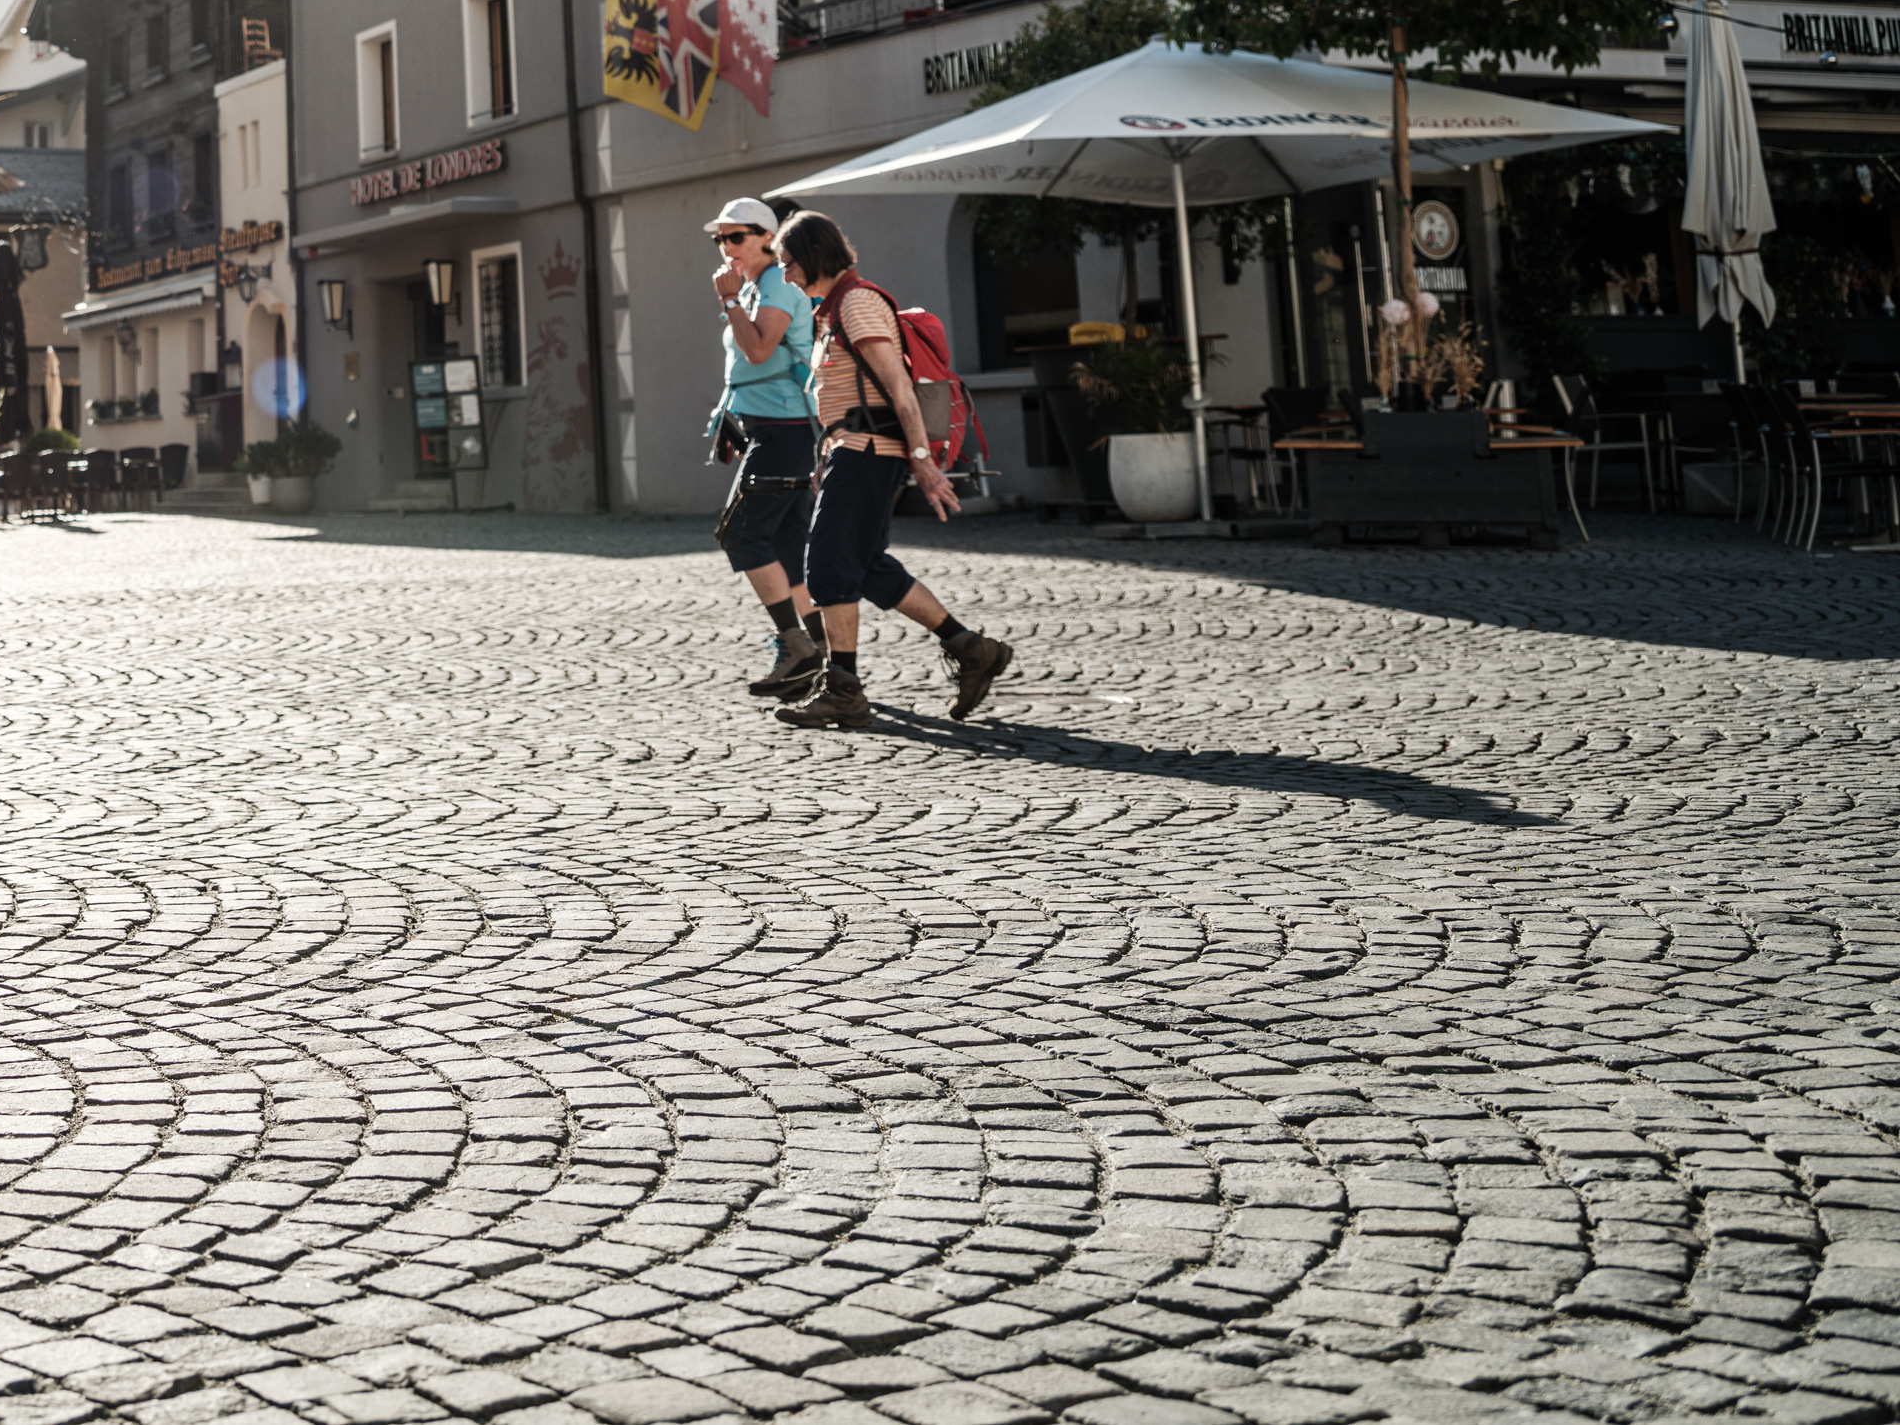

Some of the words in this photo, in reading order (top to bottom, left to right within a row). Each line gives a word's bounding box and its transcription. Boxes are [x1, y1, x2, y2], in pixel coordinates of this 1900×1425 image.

[1782, 13, 1874, 55] BRITANNIA
[350, 169, 397, 206] HOTEL
[400, 161, 422, 193] DE
[425, 138, 503, 188] LONDRES
